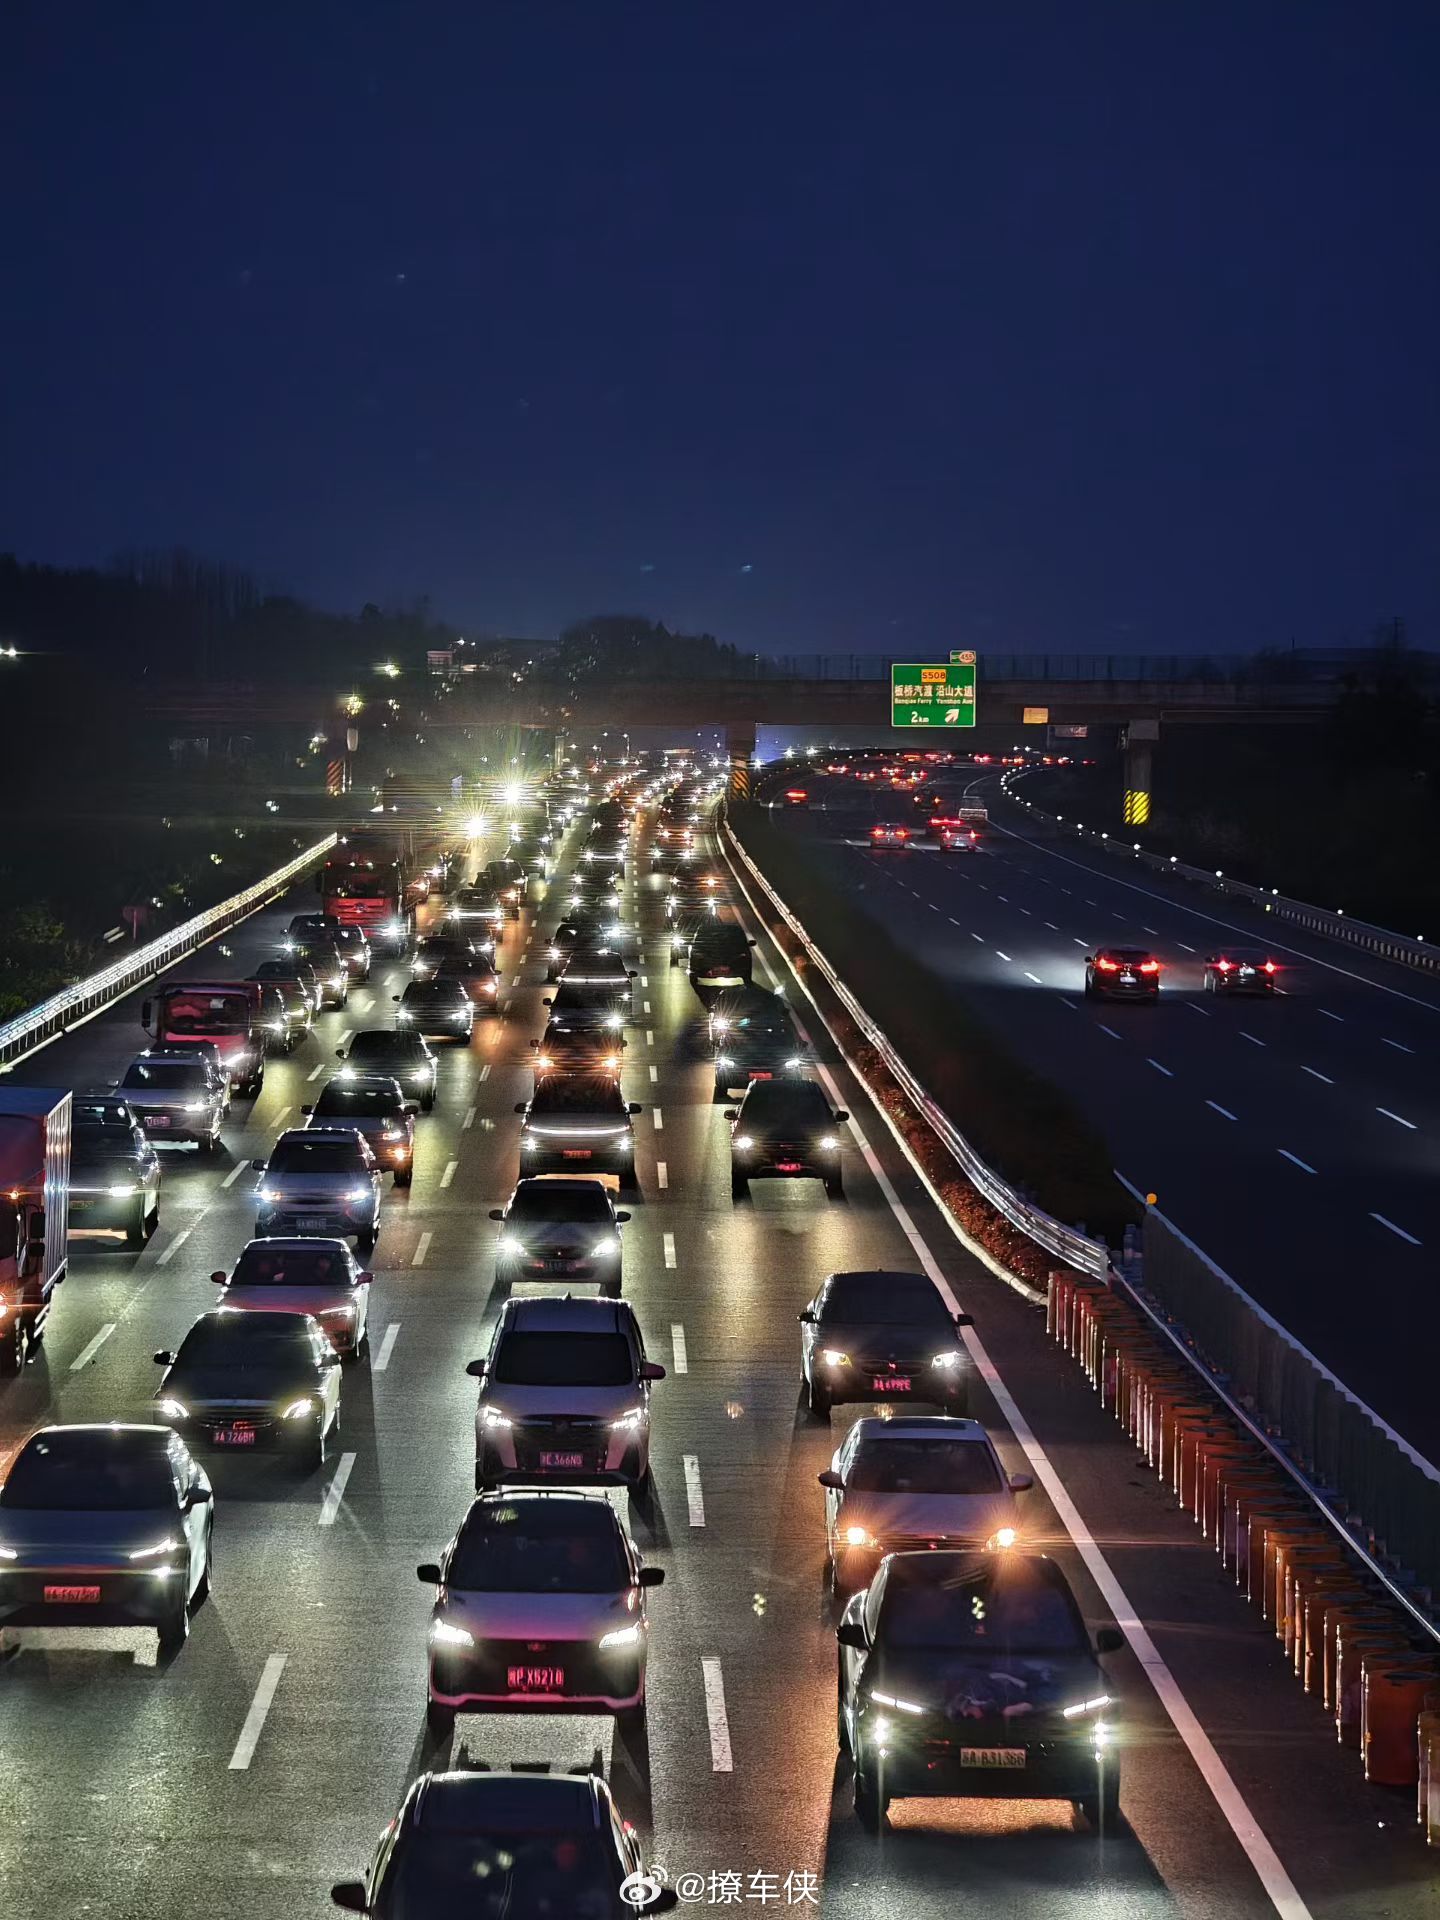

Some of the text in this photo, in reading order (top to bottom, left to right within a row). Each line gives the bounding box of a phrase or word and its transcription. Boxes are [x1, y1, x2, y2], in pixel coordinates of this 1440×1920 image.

[922, 671, 946, 679] S508
[894, 685, 973, 697] 板桥汽渡 沿山大道
[911, 711, 929, 723] 2km
